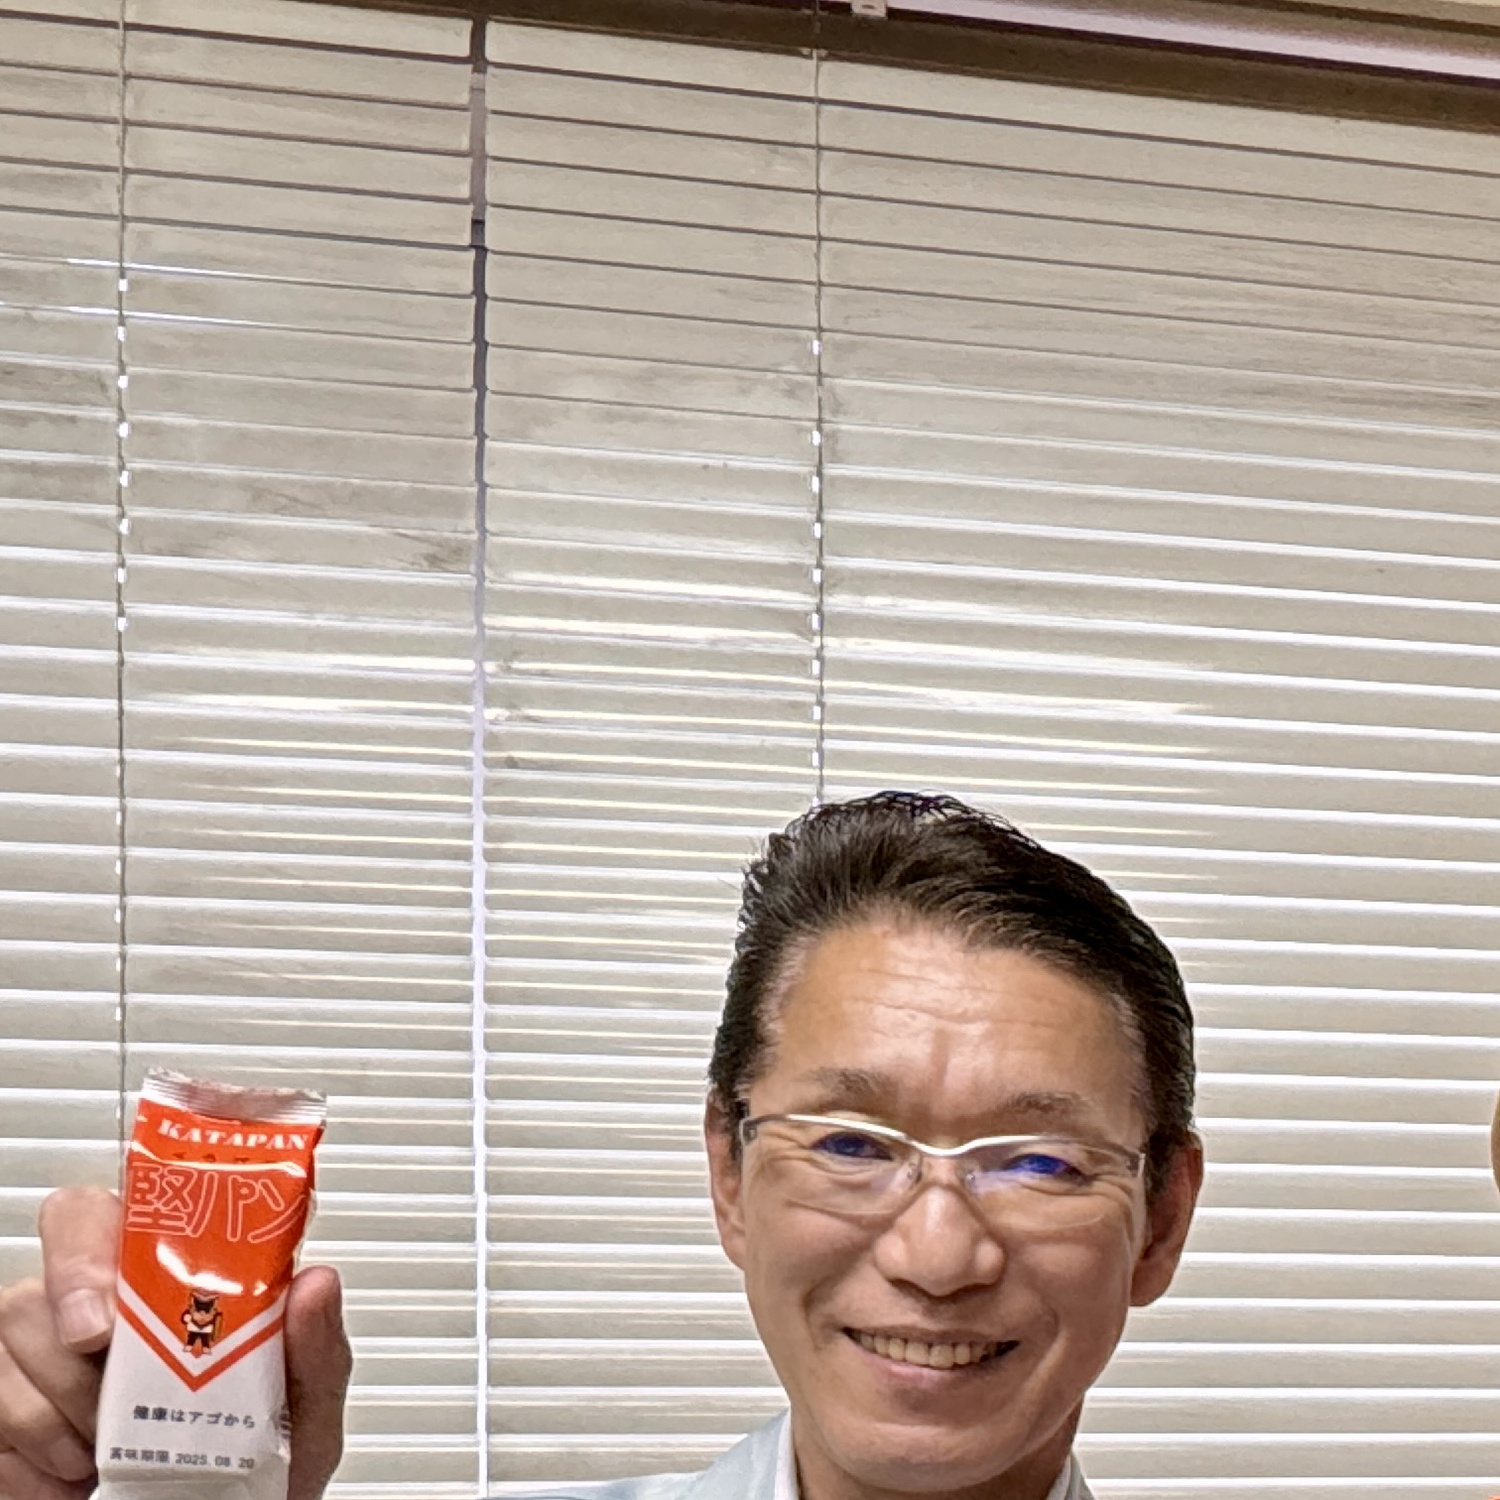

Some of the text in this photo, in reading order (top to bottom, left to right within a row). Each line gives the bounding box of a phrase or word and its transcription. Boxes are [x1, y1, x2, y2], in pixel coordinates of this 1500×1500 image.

[157, 1118, 309, 1151] KATAPAN
[133, 1404, 256, 1429] 健康はアゴから
